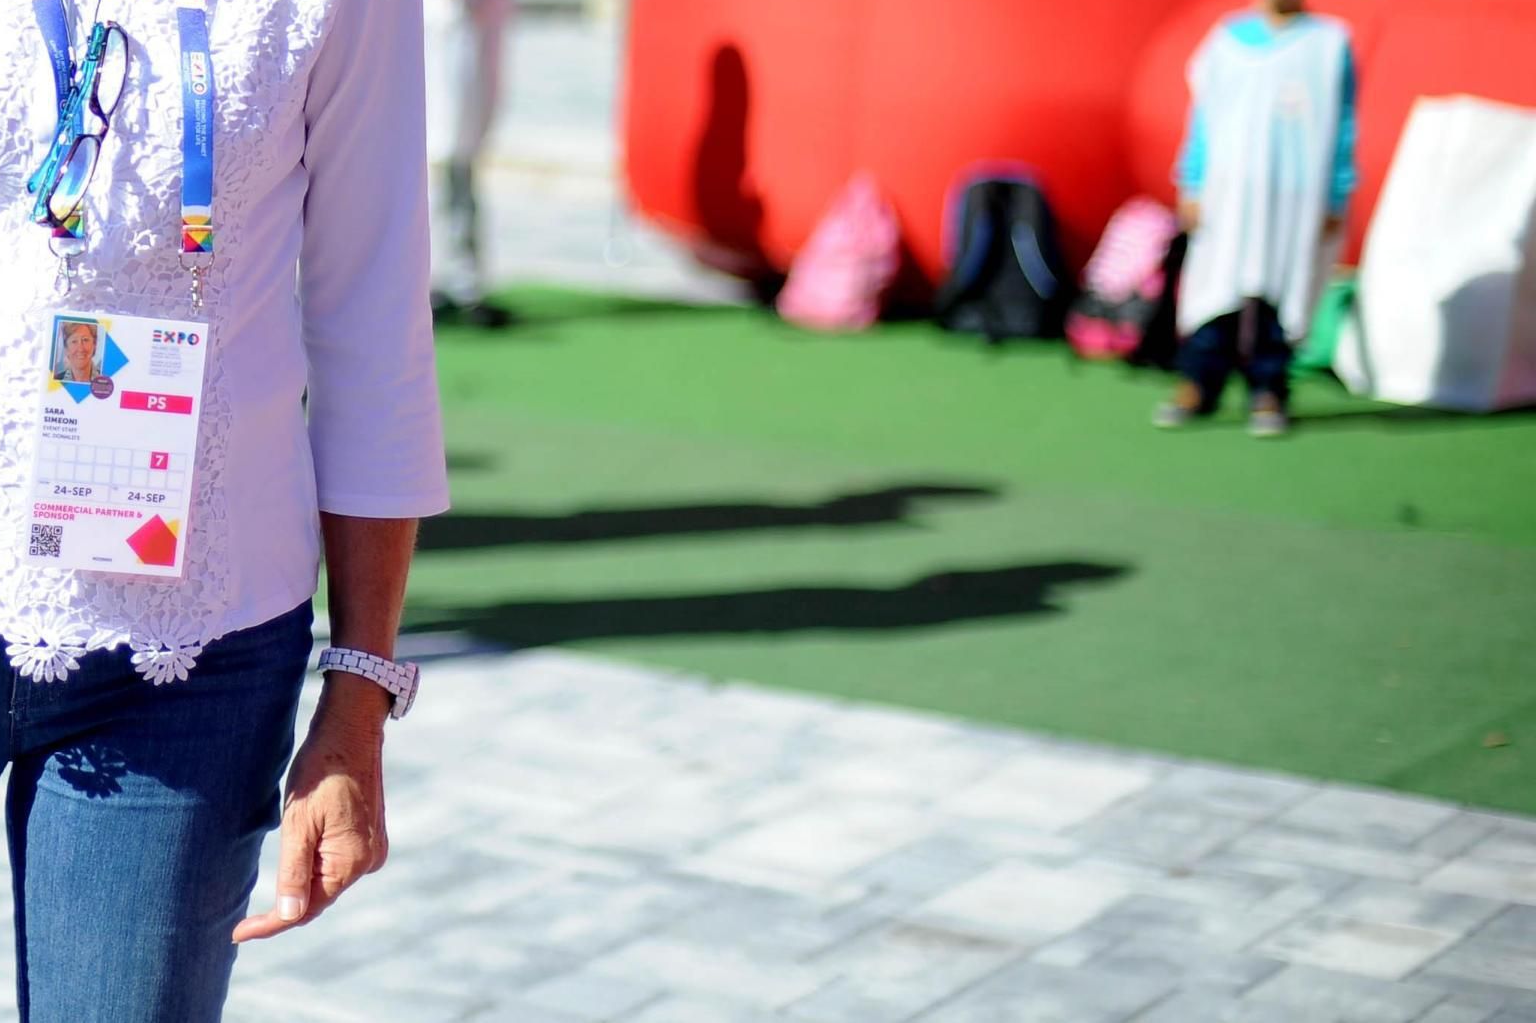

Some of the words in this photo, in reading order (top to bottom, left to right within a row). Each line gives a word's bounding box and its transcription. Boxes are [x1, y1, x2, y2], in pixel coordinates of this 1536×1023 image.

[152, 330, 199, 345] EXPO
[147, 395, 167, 410] PS
[44, 407, 65, 415] SARA
[43, 416, 78, 425] SIMEONI
[155, 454, 165, 467] 7
[54, 485, 92, 496] 24-SEP
[128, 491, 166, 503] 24-SEP
[33, 503, 94, 515] COMMERCIAL
[95, 508, 134, 518] PARTNER
[33, 511, 75, 521] SPONSOR
